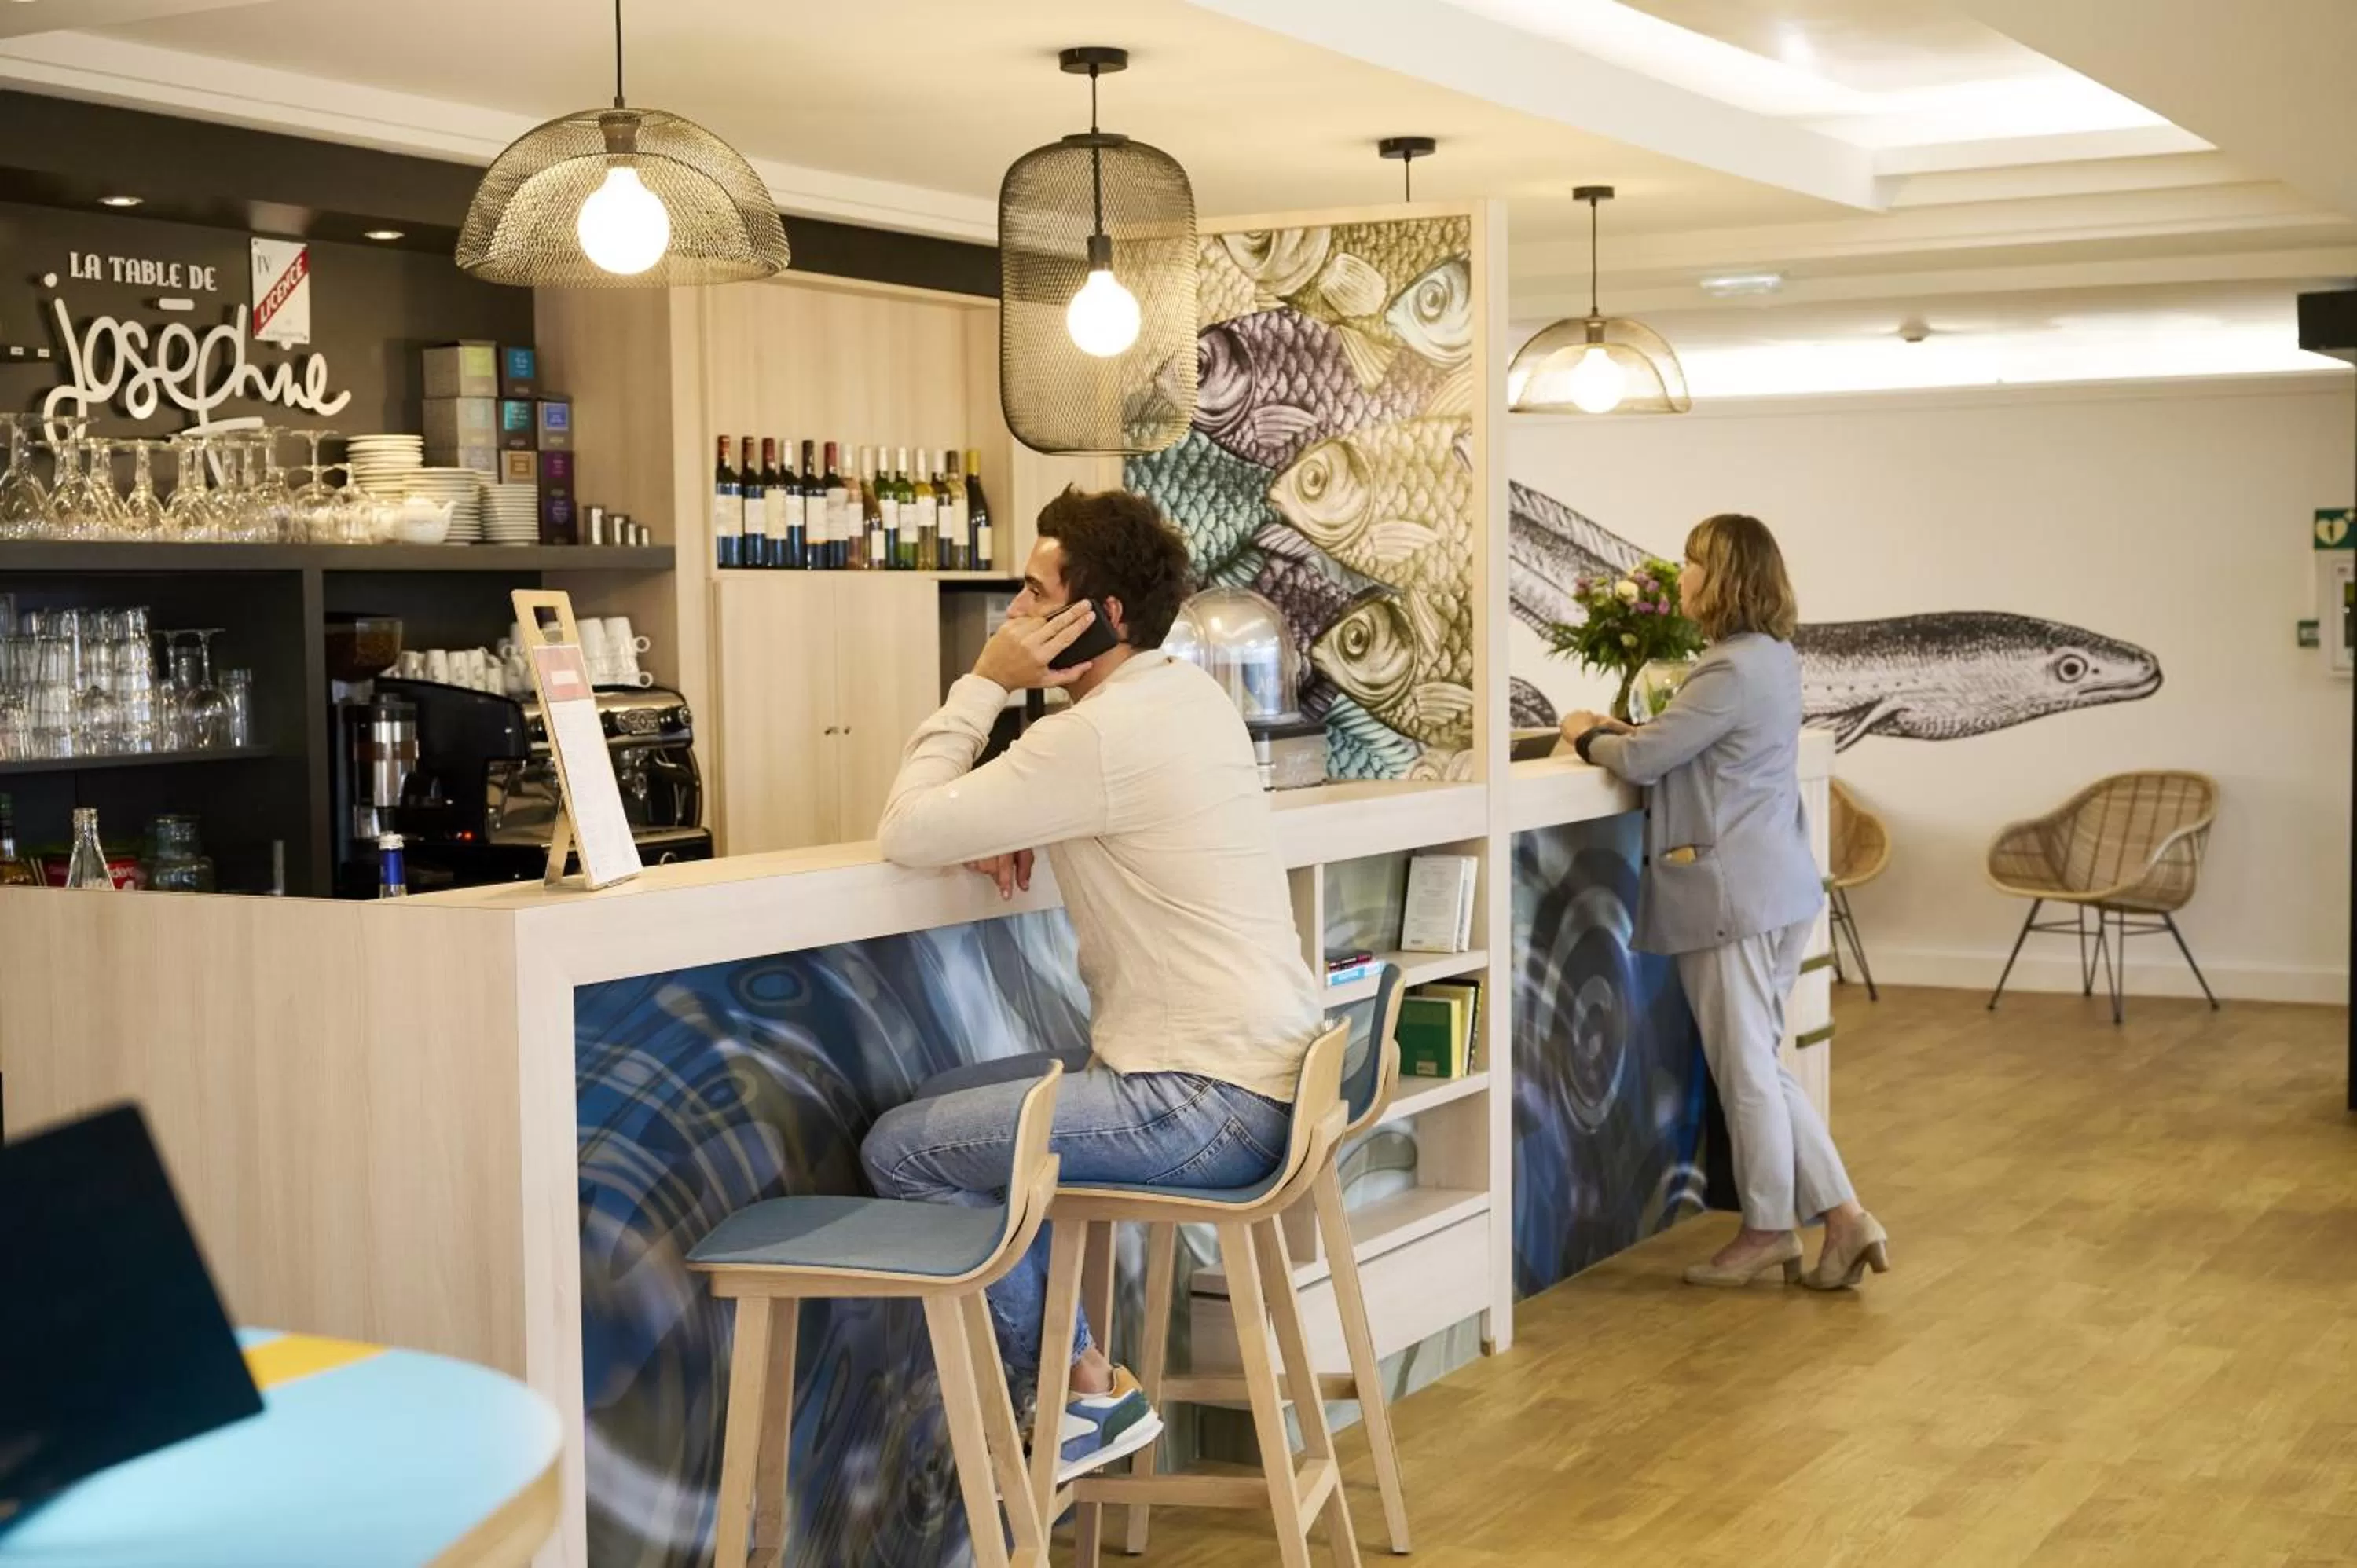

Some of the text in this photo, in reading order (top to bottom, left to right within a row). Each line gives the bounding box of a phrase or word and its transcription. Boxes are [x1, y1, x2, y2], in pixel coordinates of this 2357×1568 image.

[70, 251, 218, 291] LA TABLE DE
[260, 255, 305, 324] LICENCE
